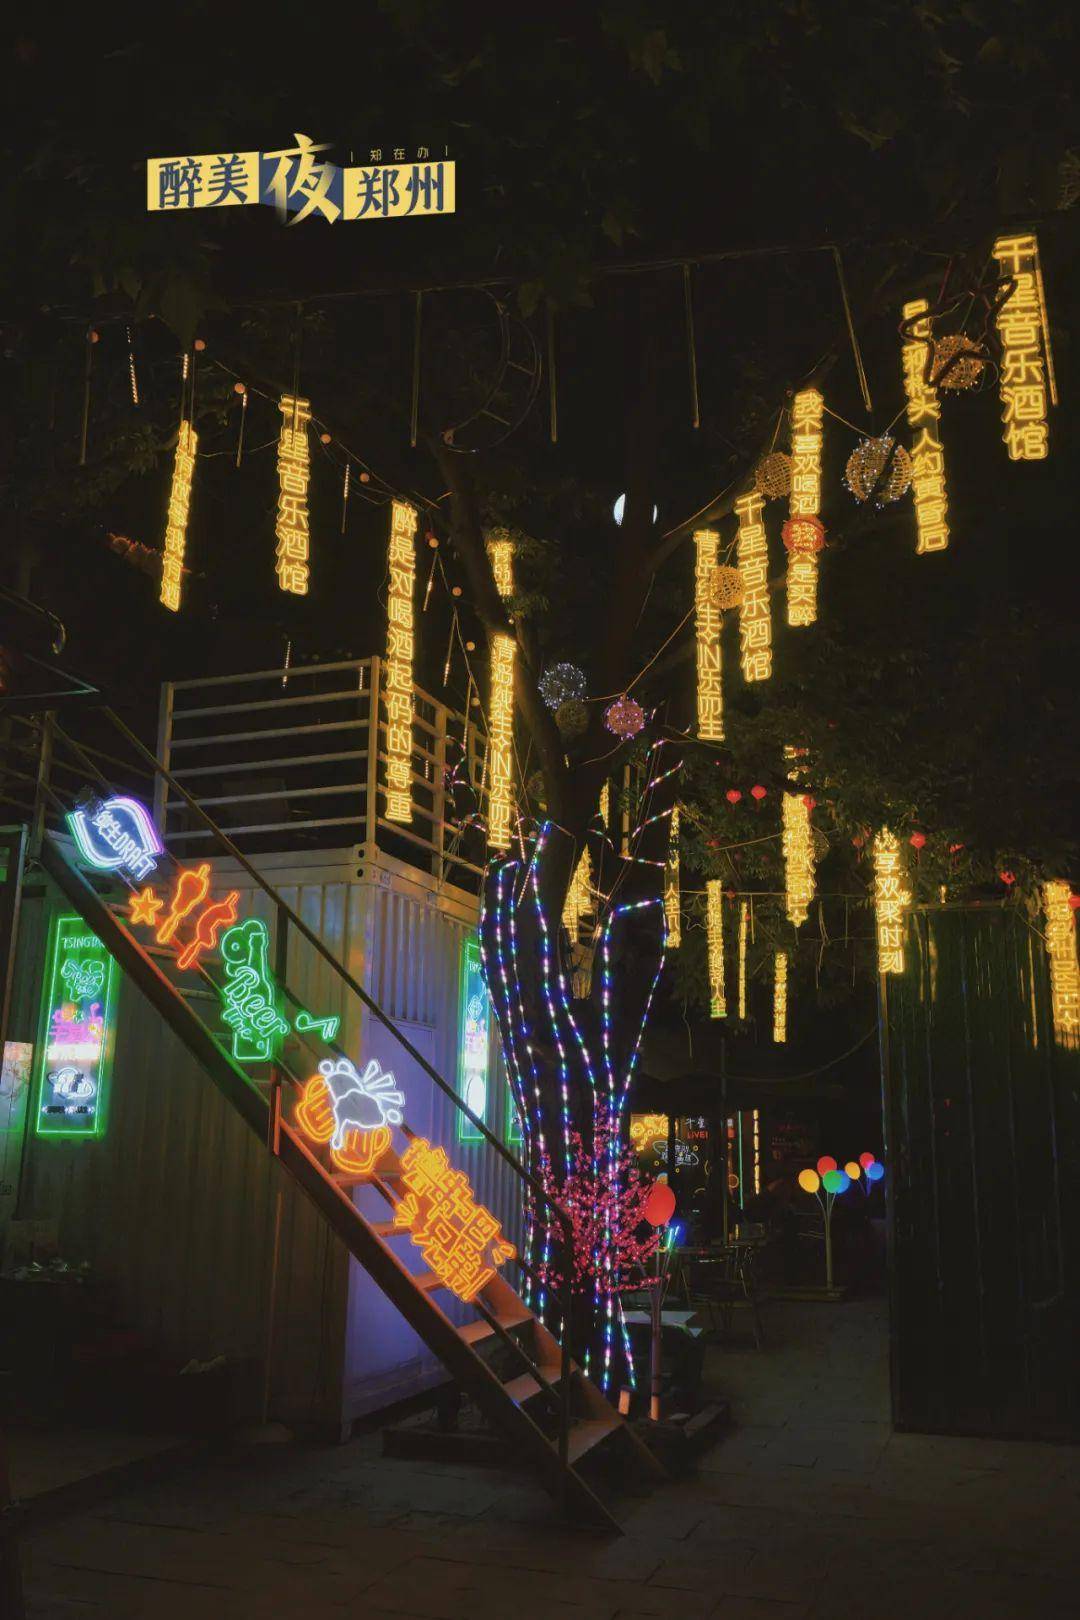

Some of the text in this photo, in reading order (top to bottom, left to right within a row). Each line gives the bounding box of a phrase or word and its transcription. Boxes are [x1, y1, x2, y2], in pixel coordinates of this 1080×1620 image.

[993, 234, 1049, 461] 千星音乐酒馆
[273, 393, 312, 597] 千星音乐酒馆
[734, 491, 772, 684] 千星音乐酒馆
[384, 499, 418, 825] 醉是对喝酒起码的尊重
[61, 935, 105, 950] TSINGTA
[223, 965, 289, 1038] Beer
